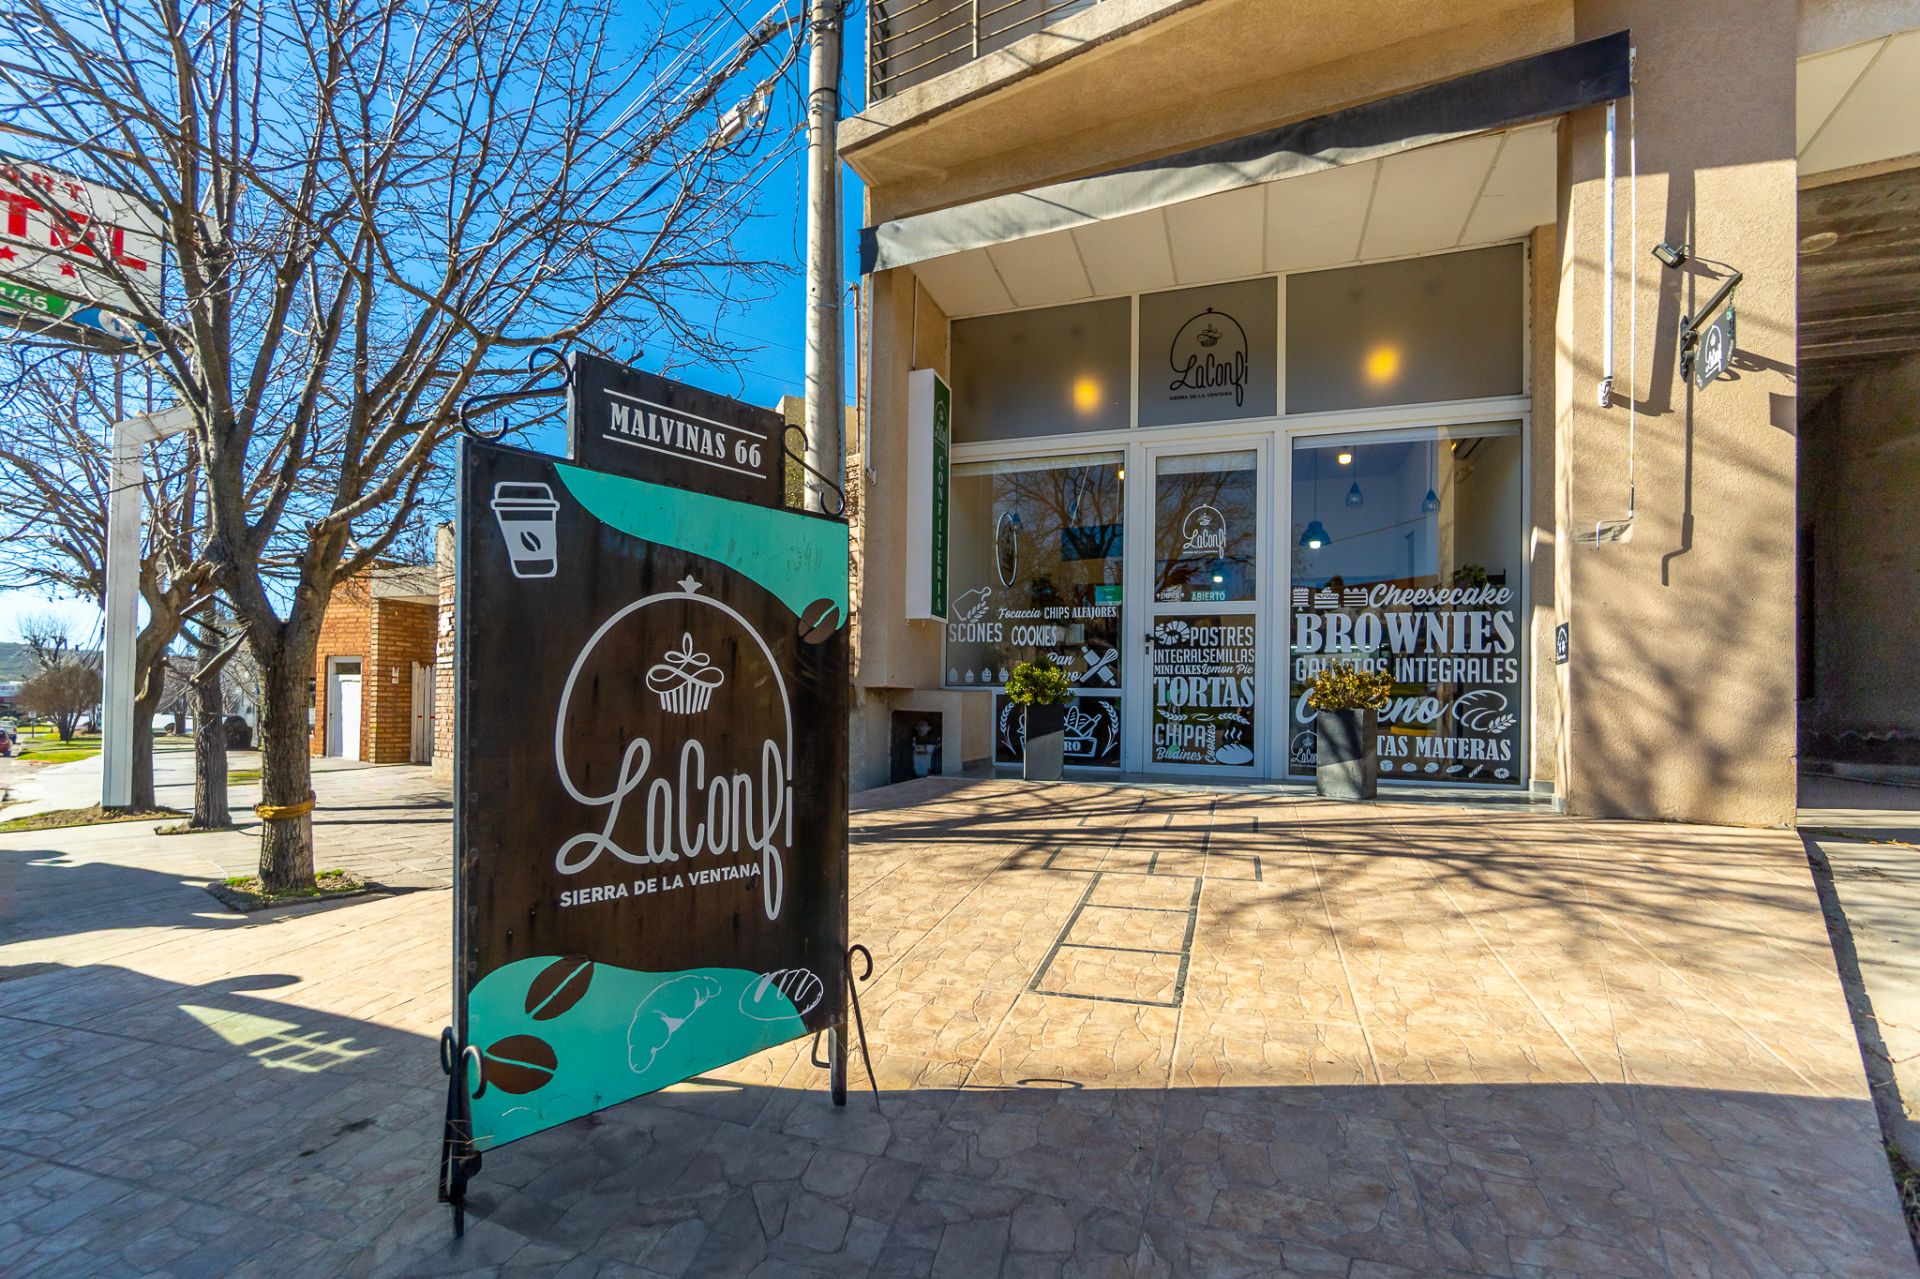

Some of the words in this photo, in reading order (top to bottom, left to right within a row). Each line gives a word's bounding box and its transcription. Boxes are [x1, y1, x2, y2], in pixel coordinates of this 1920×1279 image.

[610, 402, 726, 459] MALVINAS
[734, 439, 762, 468] 66
[1191, 591, 1226, 601] ABIERTO
[1369, 583, 1514, 609] Cheesecake
[998, 608, 1042, 620] Focaccia
[1044, 607, 1070, 619] CHIPS
[1071, 606, 1117, 619] ALFAJORES
[949, 622, 1003, 643] SCONES
[1011, 625, 1057, 647] COOKIES
[1190, 626, 1254, 647] POSTRES
[1295, 610, 1515, 654] BROWNIES
[1154, 664, 1174, 675] MINI
[1236, 664, 1254, 675] Pie
[1396, 657, 1518, 684] INTEGRALES
[1153, 676, 1254, 708] TORTAS
[1155, 723, 1206, 748] CHIPA
[1156, 746, 1203, 761] Budines
[1415, 737, 1511, 760] MATERAS
[555, 737, 793, 921] LaConfi
[559, 883, 628, 908] SIERRA
[633, 879, 658, 894] DE
[662, 874, 685, 892] LA
[688, 862, 762, 886] VENTANA
